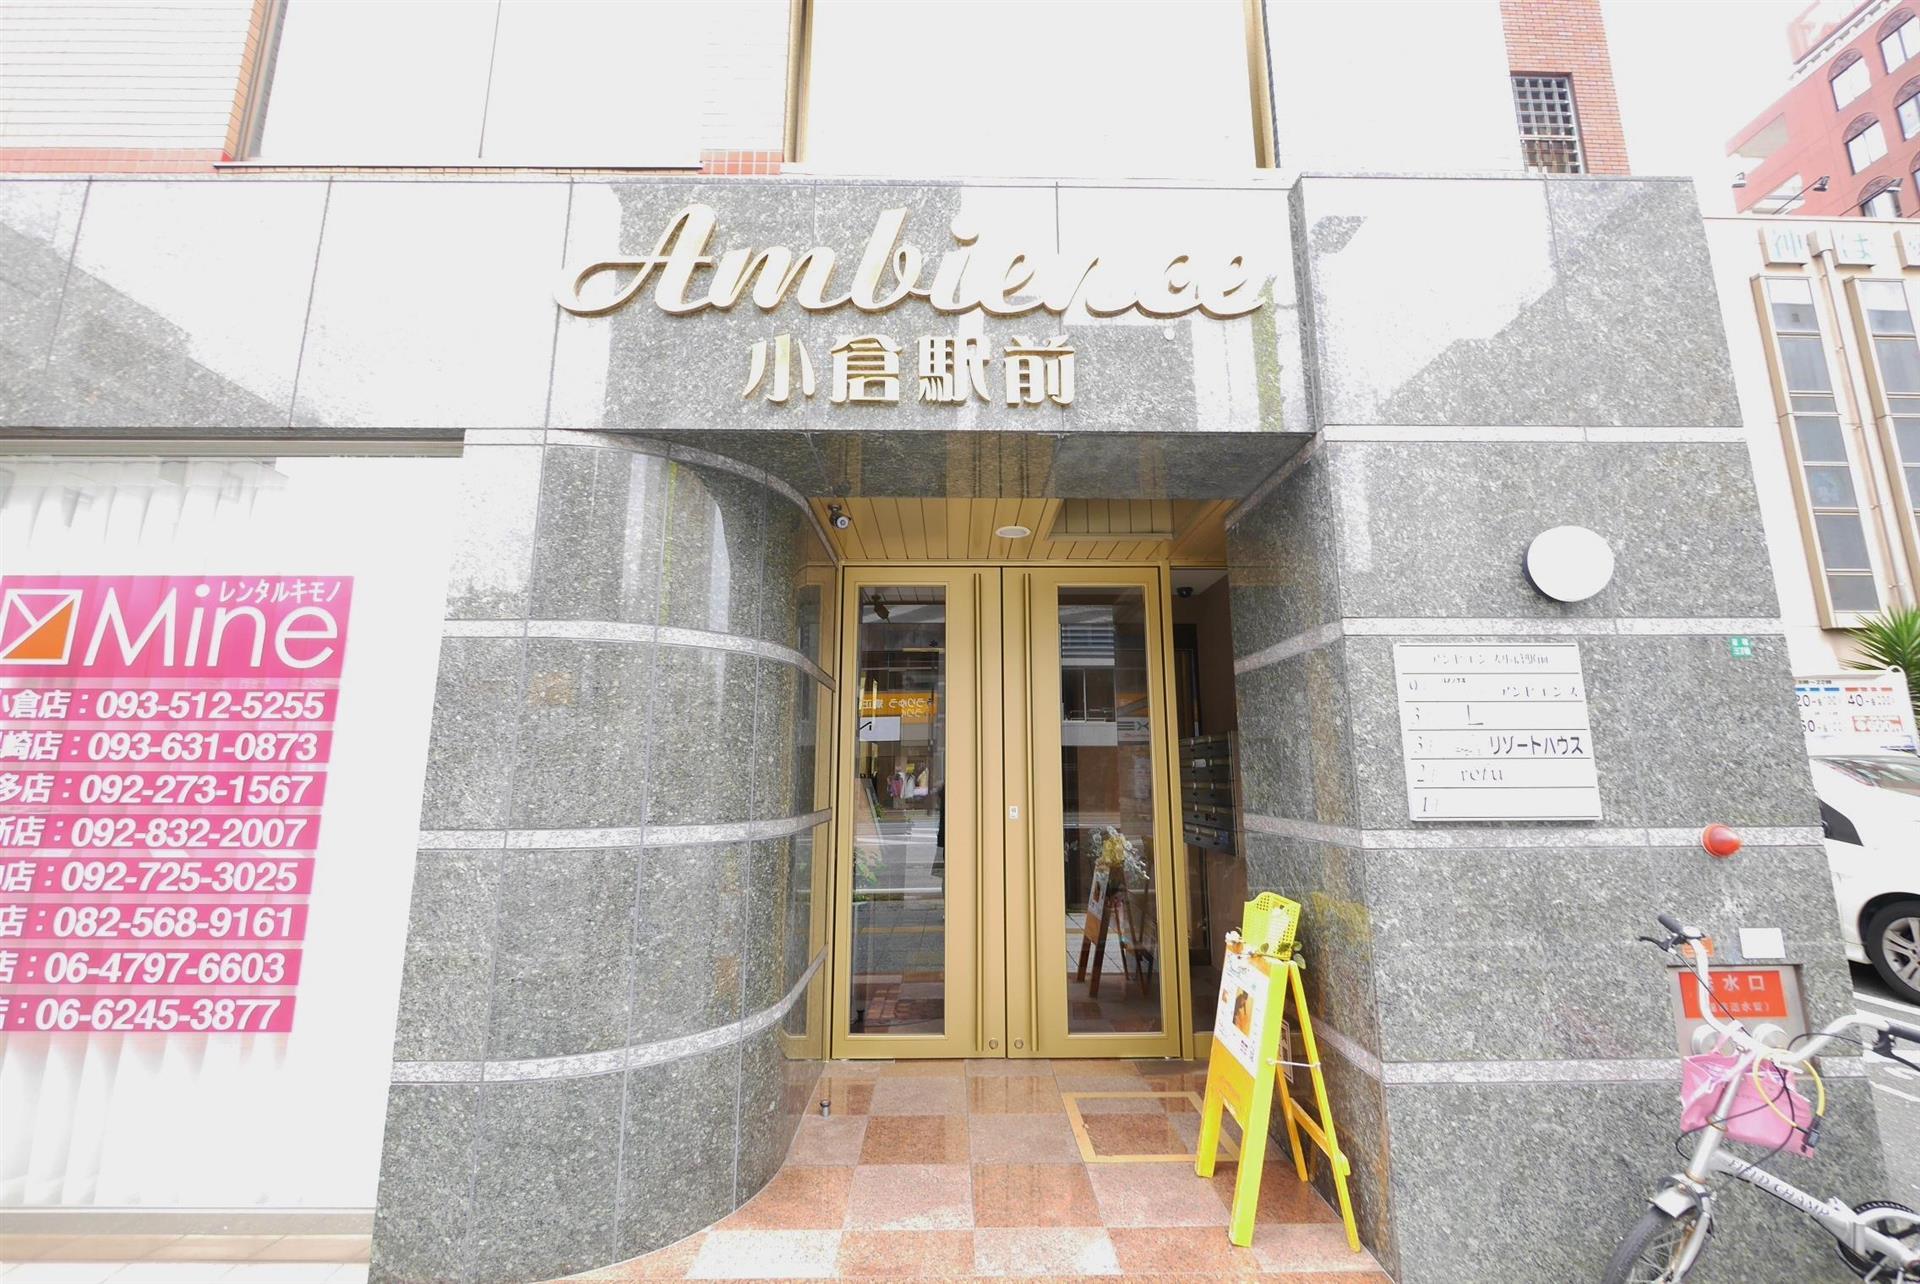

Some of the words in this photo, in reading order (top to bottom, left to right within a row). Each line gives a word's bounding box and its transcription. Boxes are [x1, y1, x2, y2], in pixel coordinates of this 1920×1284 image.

[554, 204, 1269, 318] Ambience
[742, 333, 1076, 406] 小倉駅前
[219, 579, 341, 604] レンタルキモノ
[83, 584, 338, 669] Mine
[95, 690, 325, 720] 093-512-5255
[0, 730, 81, 761] 崎店：
[88, 731, 318, 761] 093-631-0873
[80, 773, 314, 804] 092-273-1567
[71, 817, 308, 848] 092-832-2007
[61, 861, 299, 892] 092-725-3025
[53, 906, 294, 938] 082-568-9161
[44, 952, 286, 984] 06-4797-6603
[35, 998, 281, 1032] 06-6245-3877
